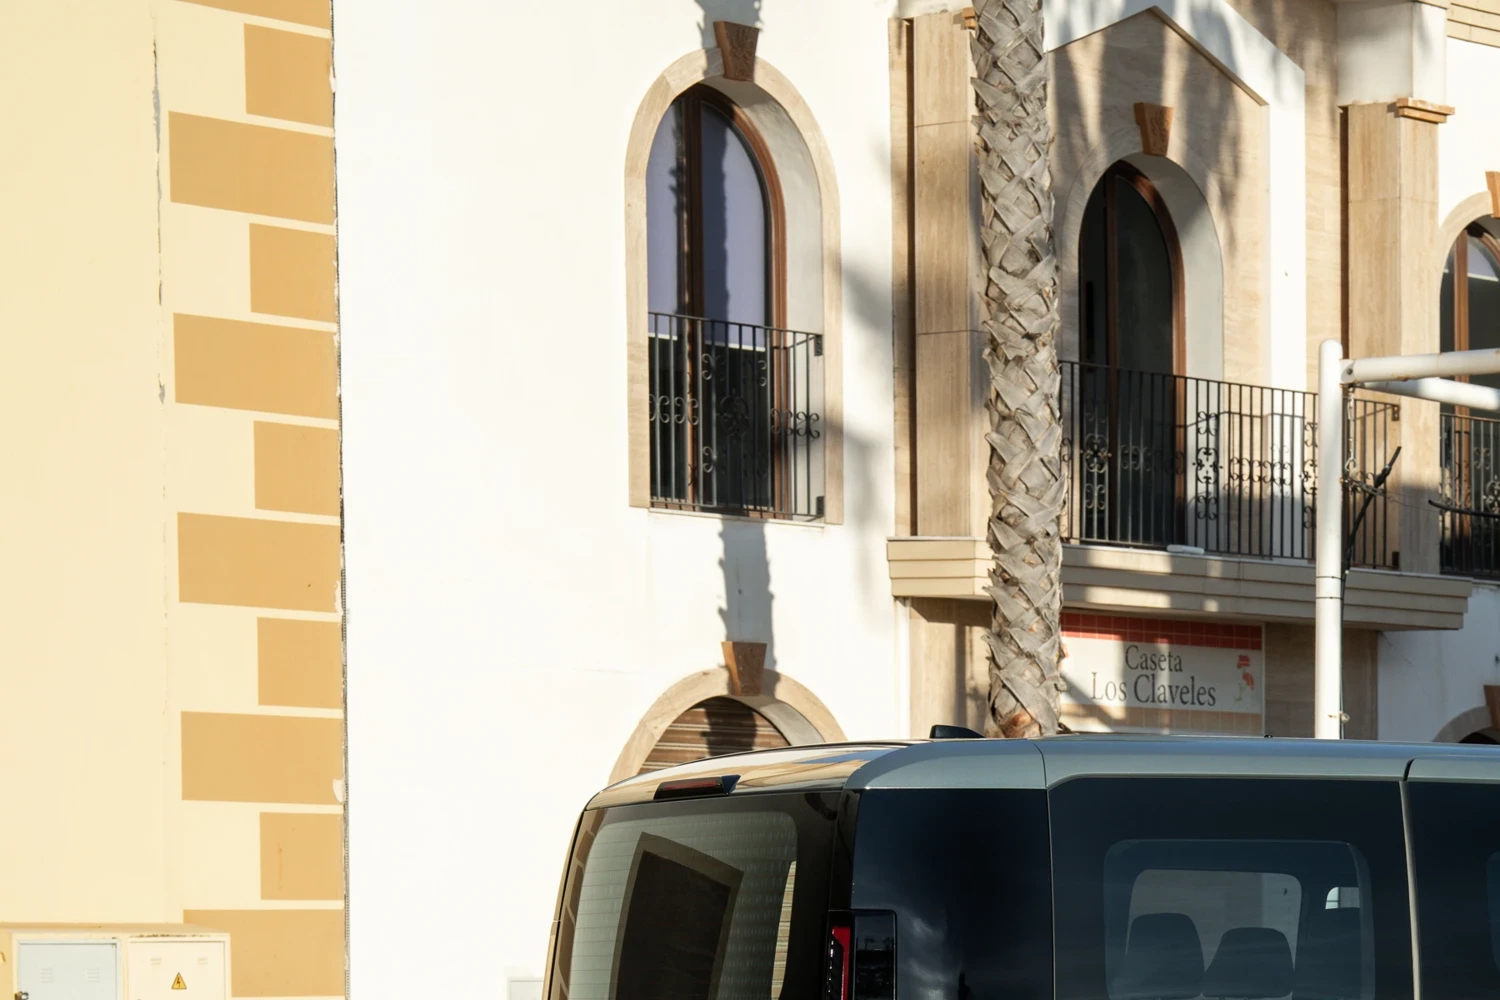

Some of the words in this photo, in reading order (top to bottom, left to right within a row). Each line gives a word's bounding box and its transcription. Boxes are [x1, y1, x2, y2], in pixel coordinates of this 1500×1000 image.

[1125, 645, 1183, 672] Caseta
[1090, 672, 1127, 701] Los
[1134, 674, 1216, 706] Claveles
